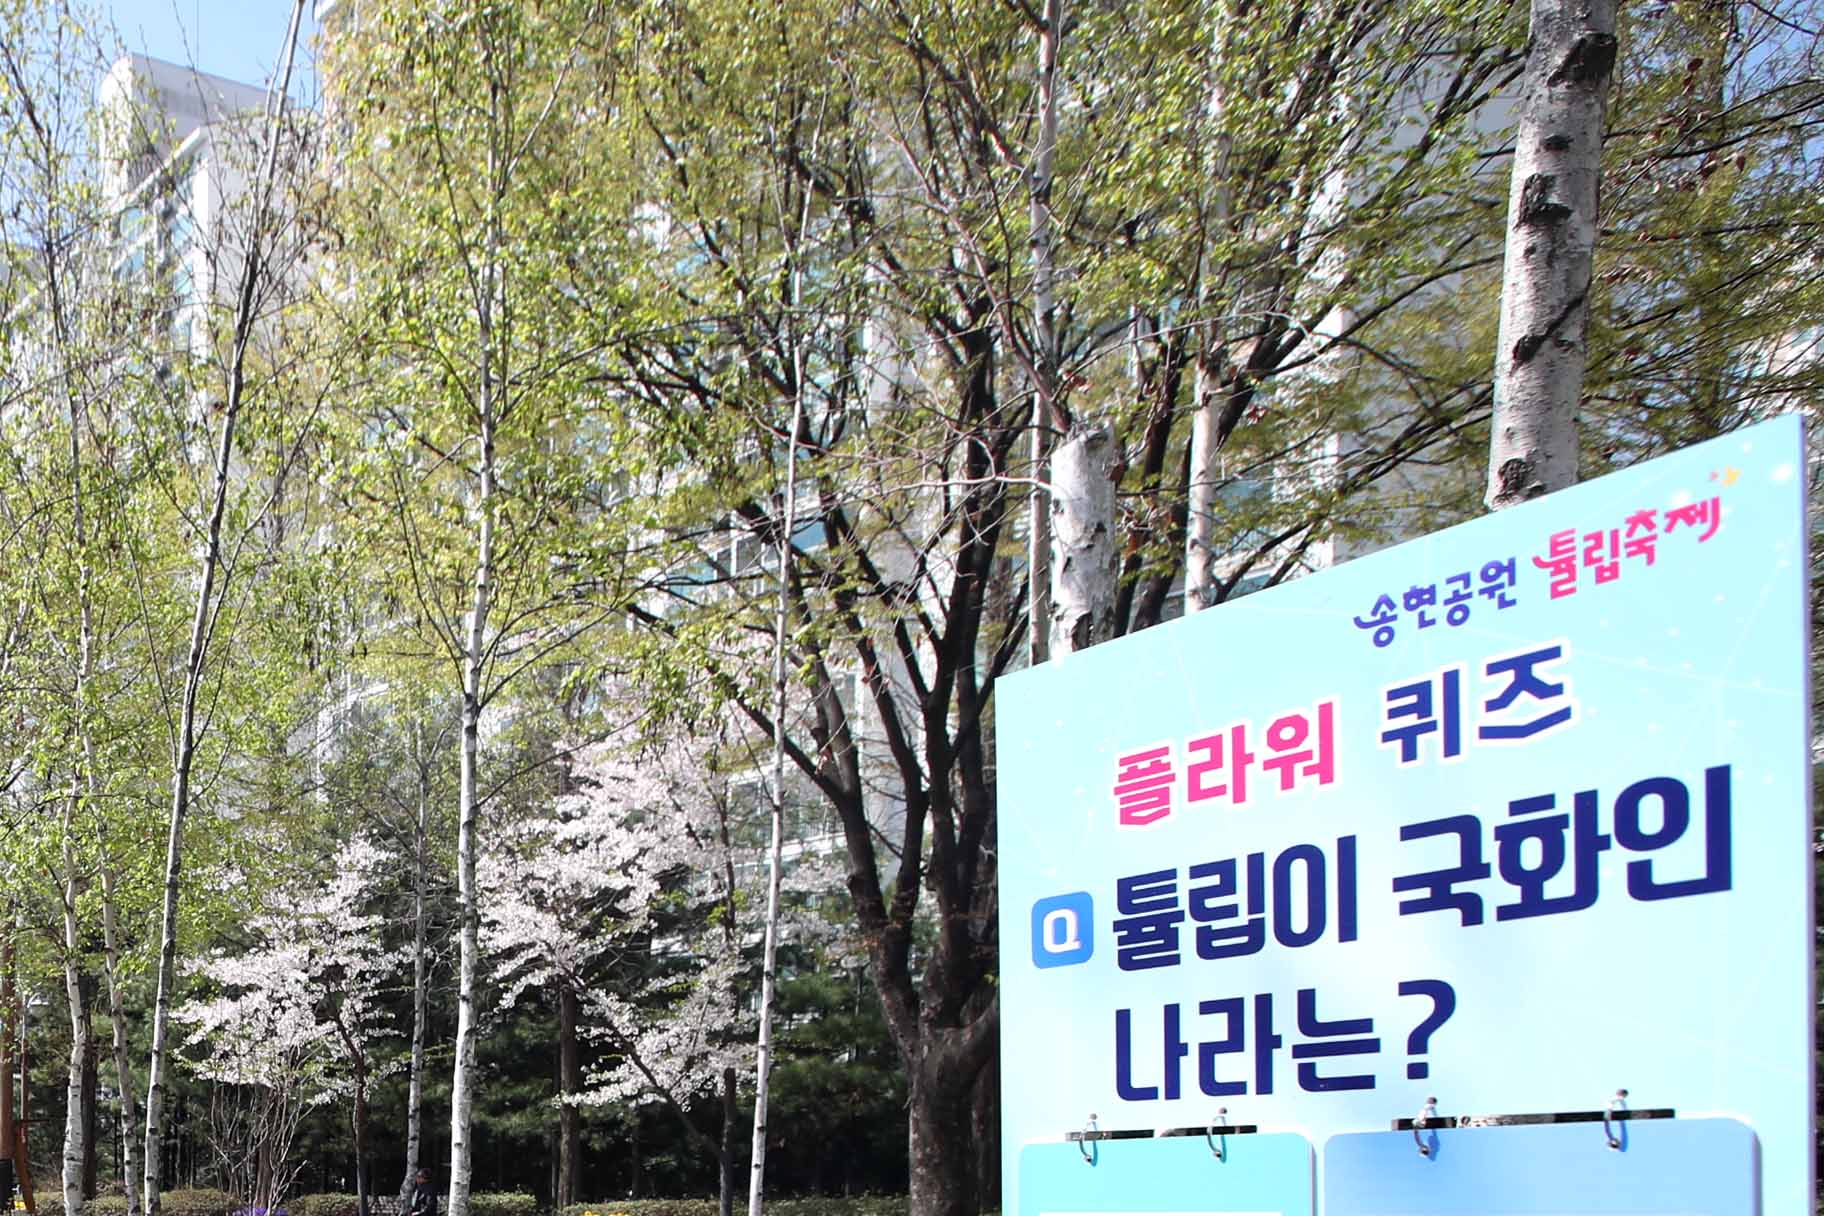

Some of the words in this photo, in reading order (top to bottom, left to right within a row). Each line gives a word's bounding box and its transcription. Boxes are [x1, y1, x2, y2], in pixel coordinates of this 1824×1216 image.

[1352, 556, 1518, 648] 송현공원
[1531, 496, 1721, 600] 튤립축제
[1113, 702, 1336, 826] 플라워
[1381, 645, 1574, 764] 퀴즈
[1112, 835, 1358, 972] 튤립이
[1392, 763, 1733, 928] 국화인
[1114, 978, 1457, 1105] 나라는?
